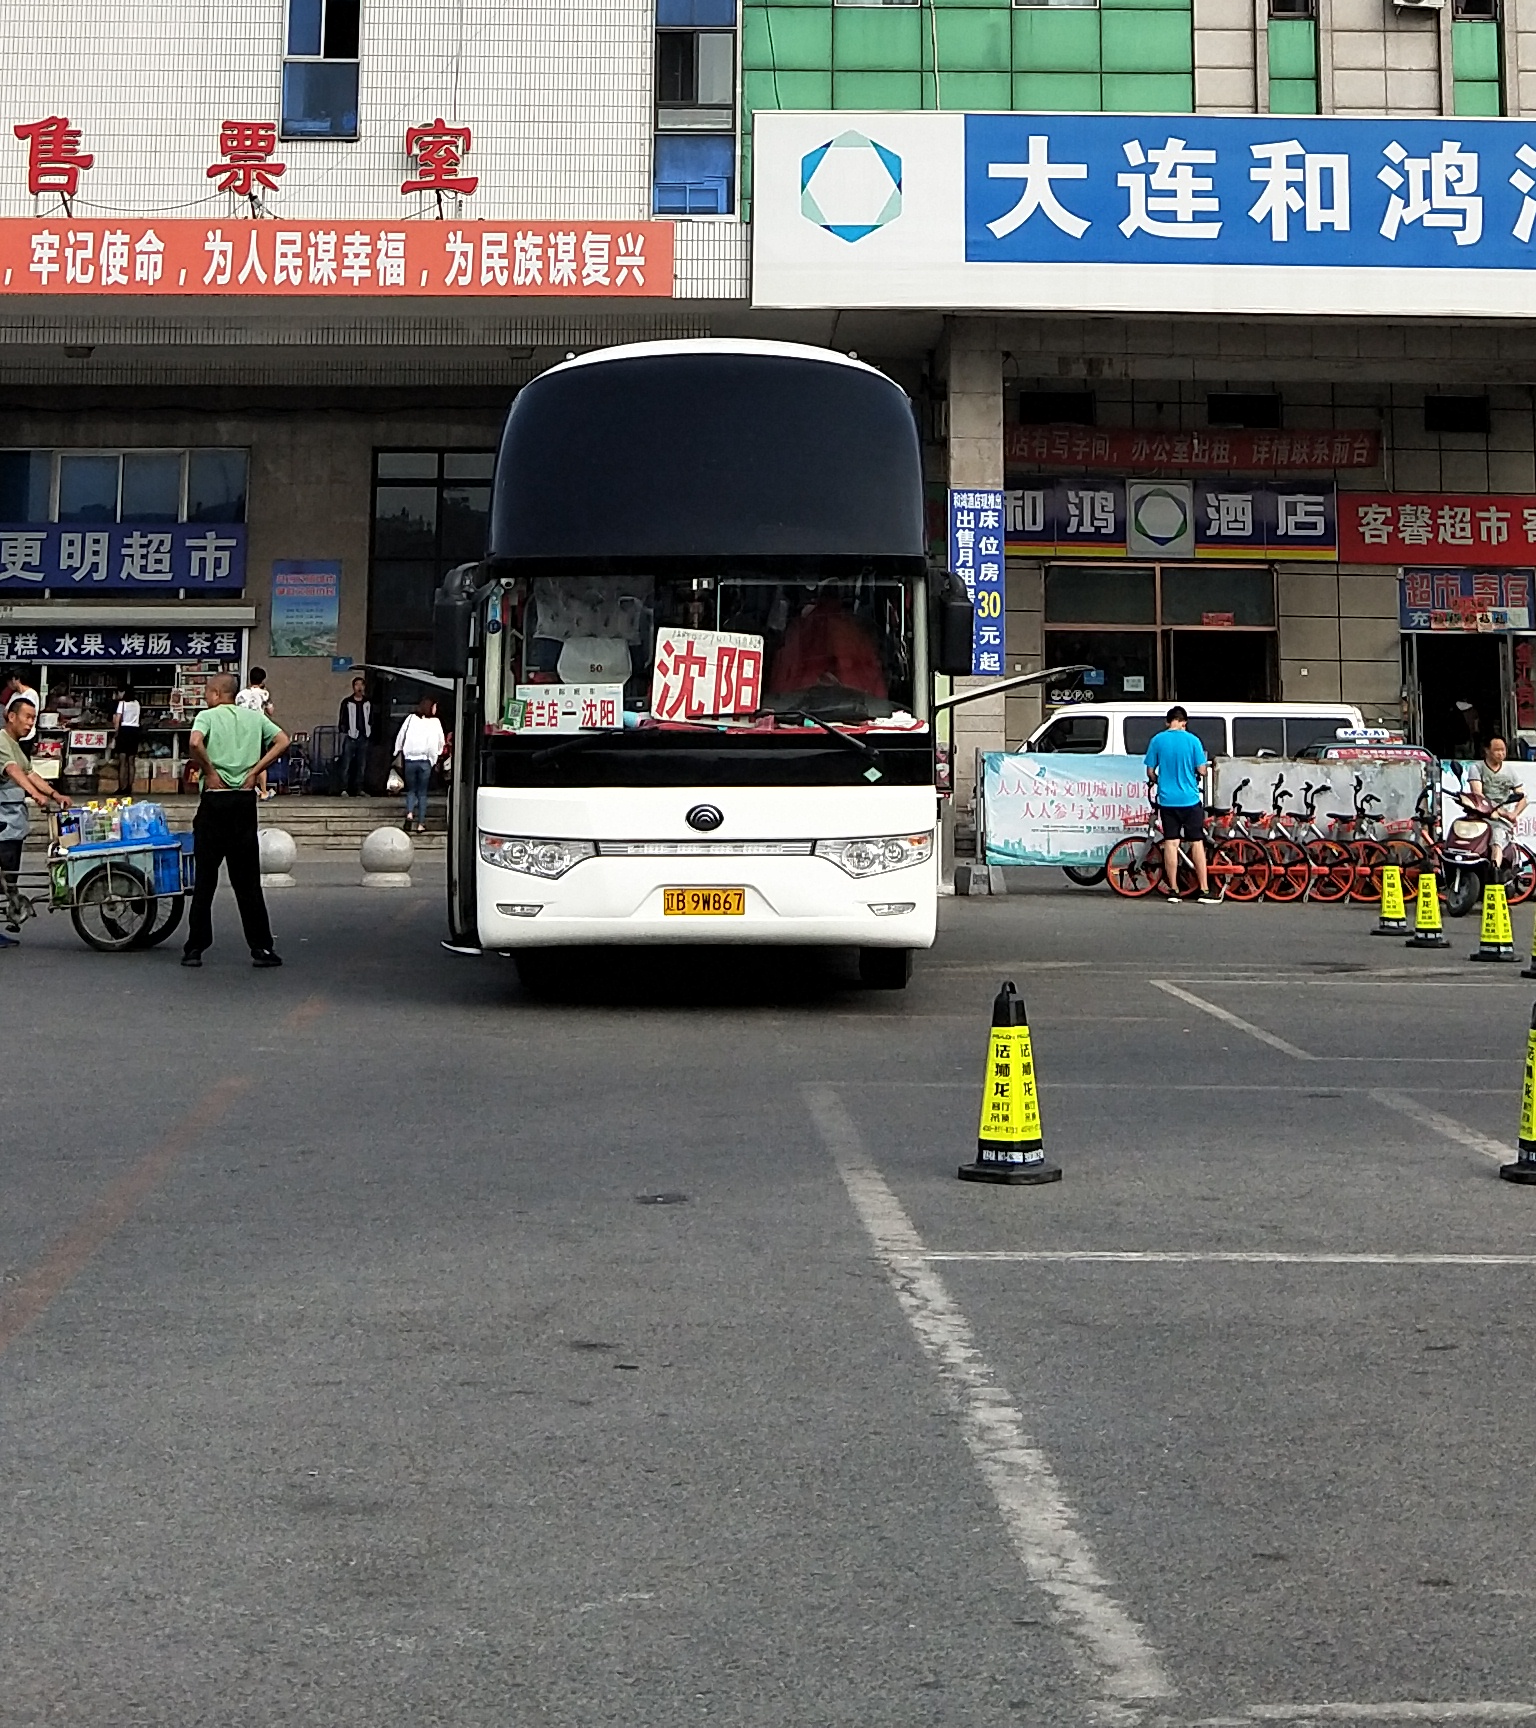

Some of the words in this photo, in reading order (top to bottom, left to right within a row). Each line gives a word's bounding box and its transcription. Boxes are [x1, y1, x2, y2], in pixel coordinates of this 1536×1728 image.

[13, 116, 479, 196] 售票室
[1004, 489, 1116, 535] 和鸿
[1205, 492, 1326, 538] 酒店
[1357, 503, 1511, 546] 客馨超市
[977, 510, 1002, 672] 床位房30元起
[1405, 573, 1461, 609] 超市
[1472, 574, 1529, 609] 寄存
[657, 640, 762, 720] 沈阳
